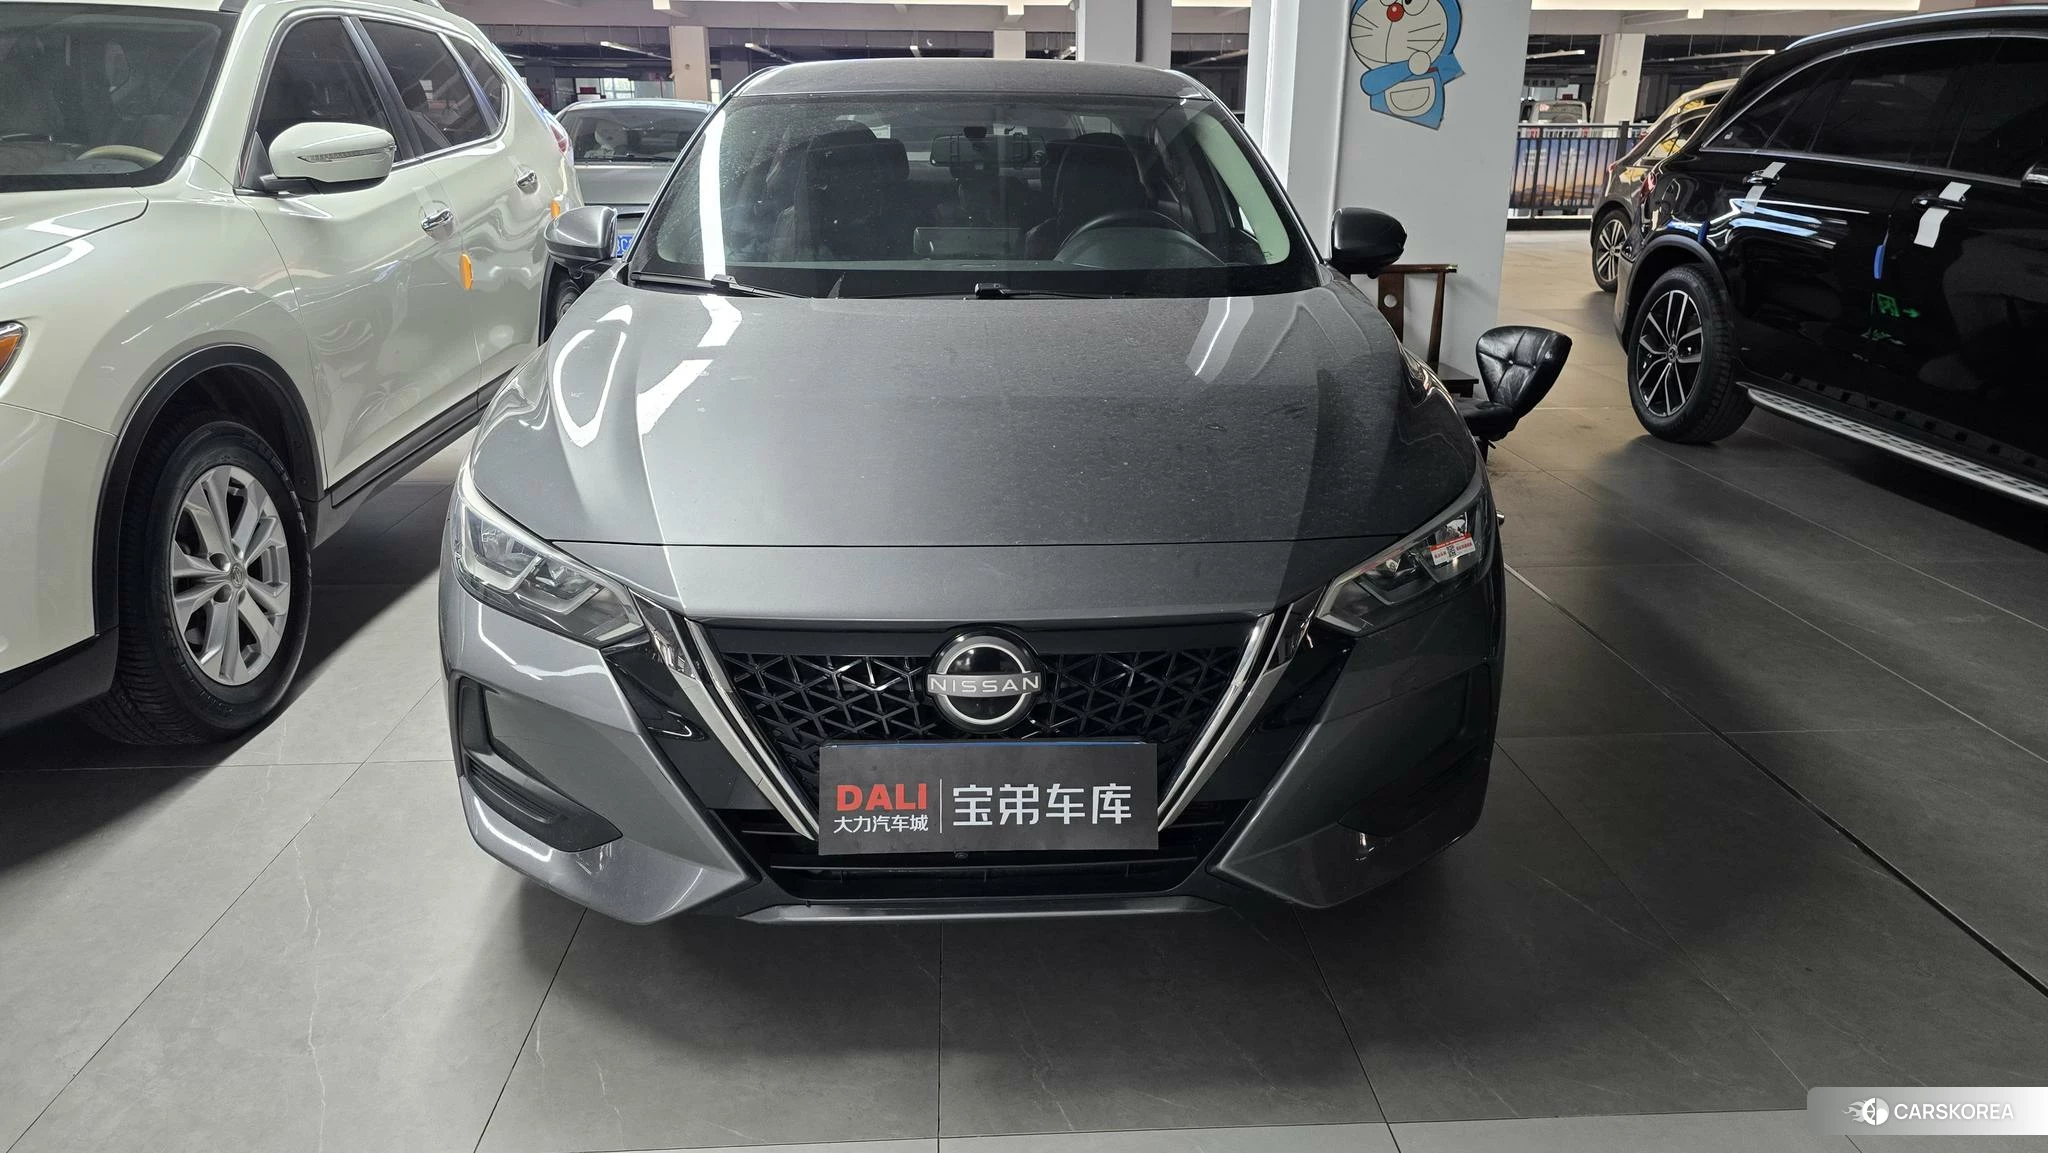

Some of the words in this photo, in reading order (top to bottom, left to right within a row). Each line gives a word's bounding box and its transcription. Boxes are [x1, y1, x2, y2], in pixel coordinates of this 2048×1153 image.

[930, 676, 1039, 692] NISSAN
[836, 784, 927, 811] DALI
[952, 783, 1132, 826] 宝弟车库
[833, 814, 929, 834] 大力汽车城
